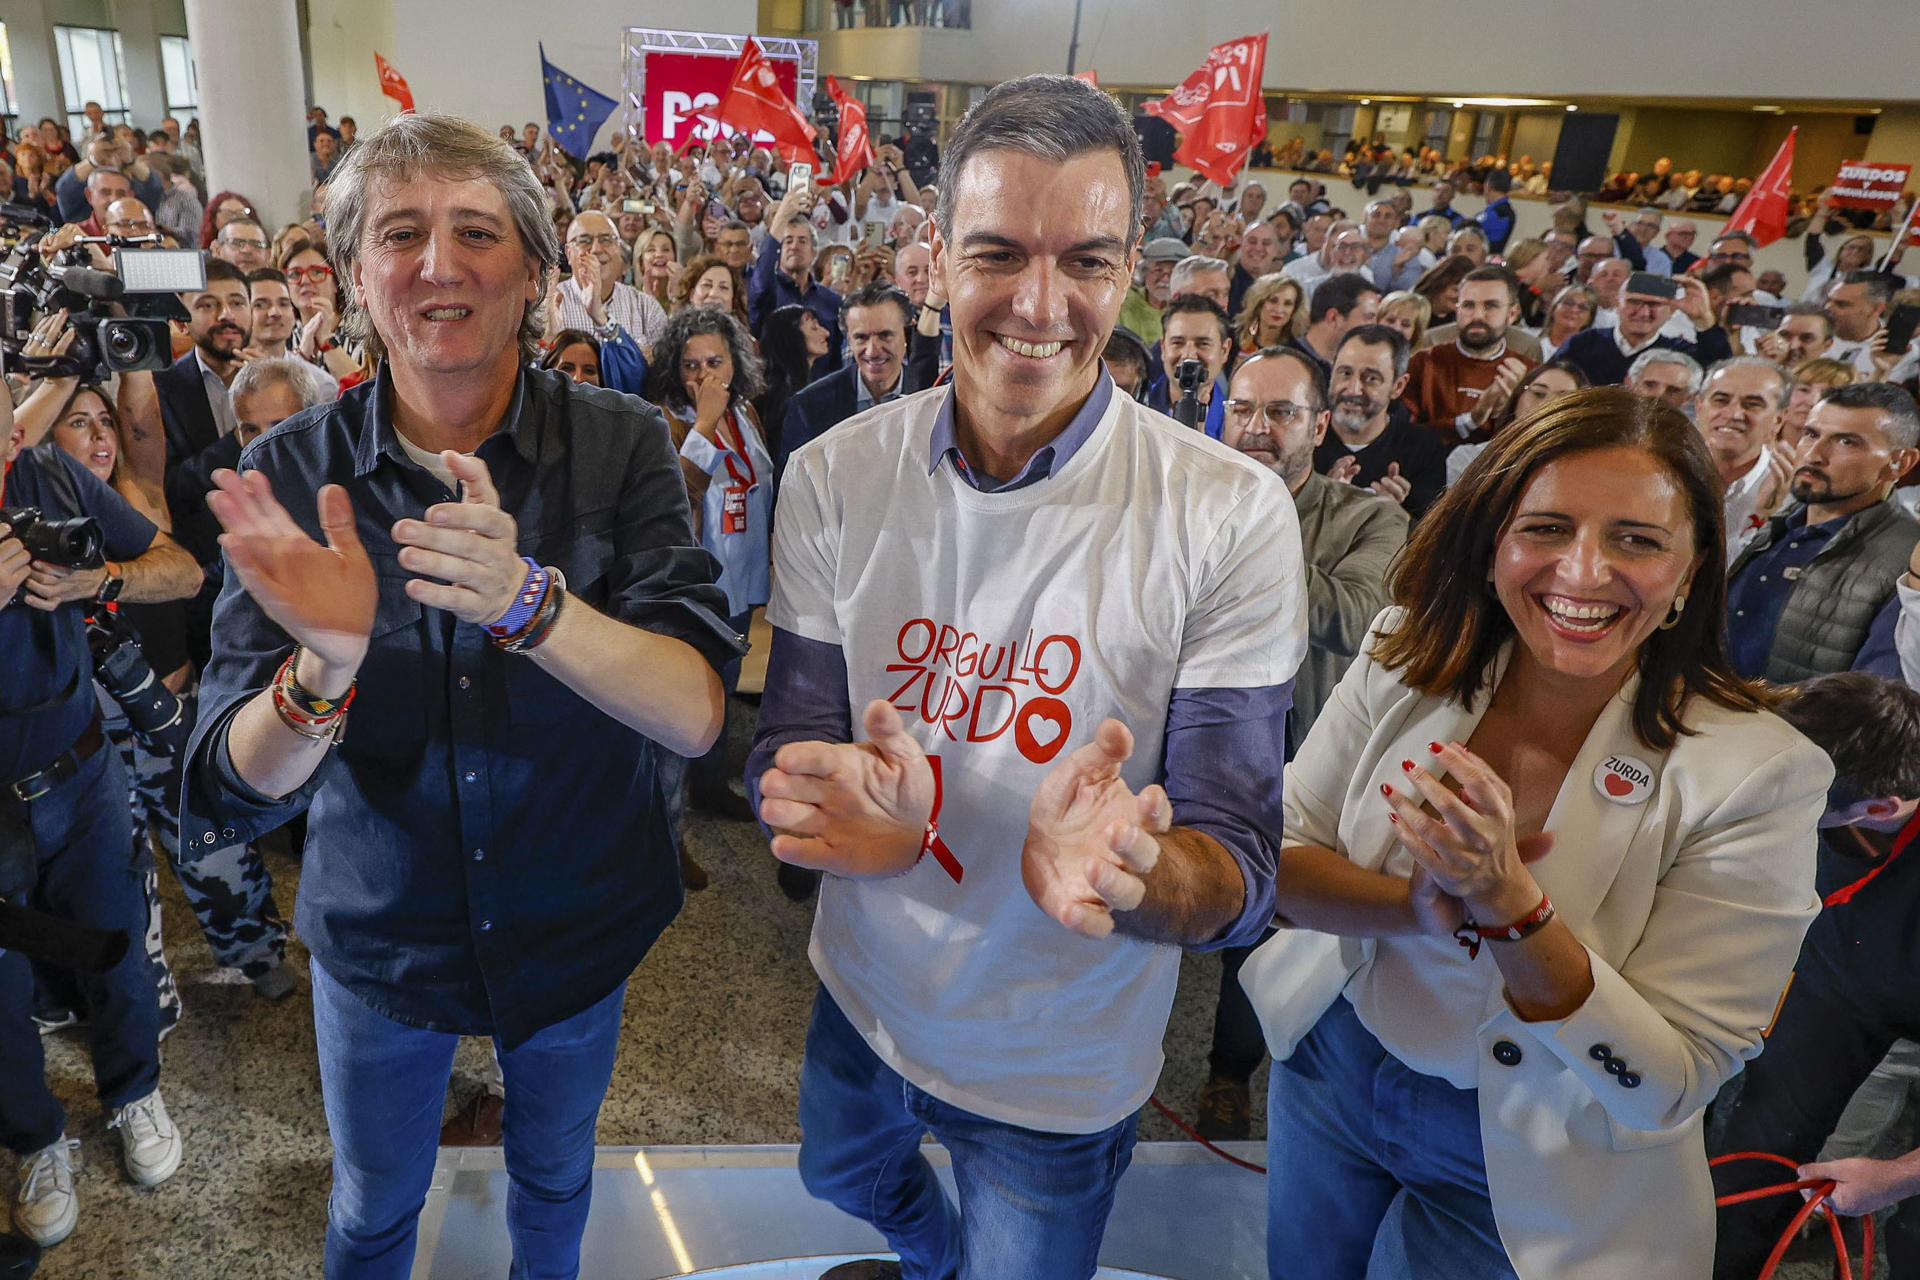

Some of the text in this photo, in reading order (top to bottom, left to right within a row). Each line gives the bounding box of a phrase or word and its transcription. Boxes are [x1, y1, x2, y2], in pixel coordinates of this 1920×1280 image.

[1838, 166, 1907, 183] ZURDOS
[897, 618, 1082, 696] ORGULLO
[885, 664, 1072, 764] ZURDO
[1604, 757, 1650, 788] ZURDA
